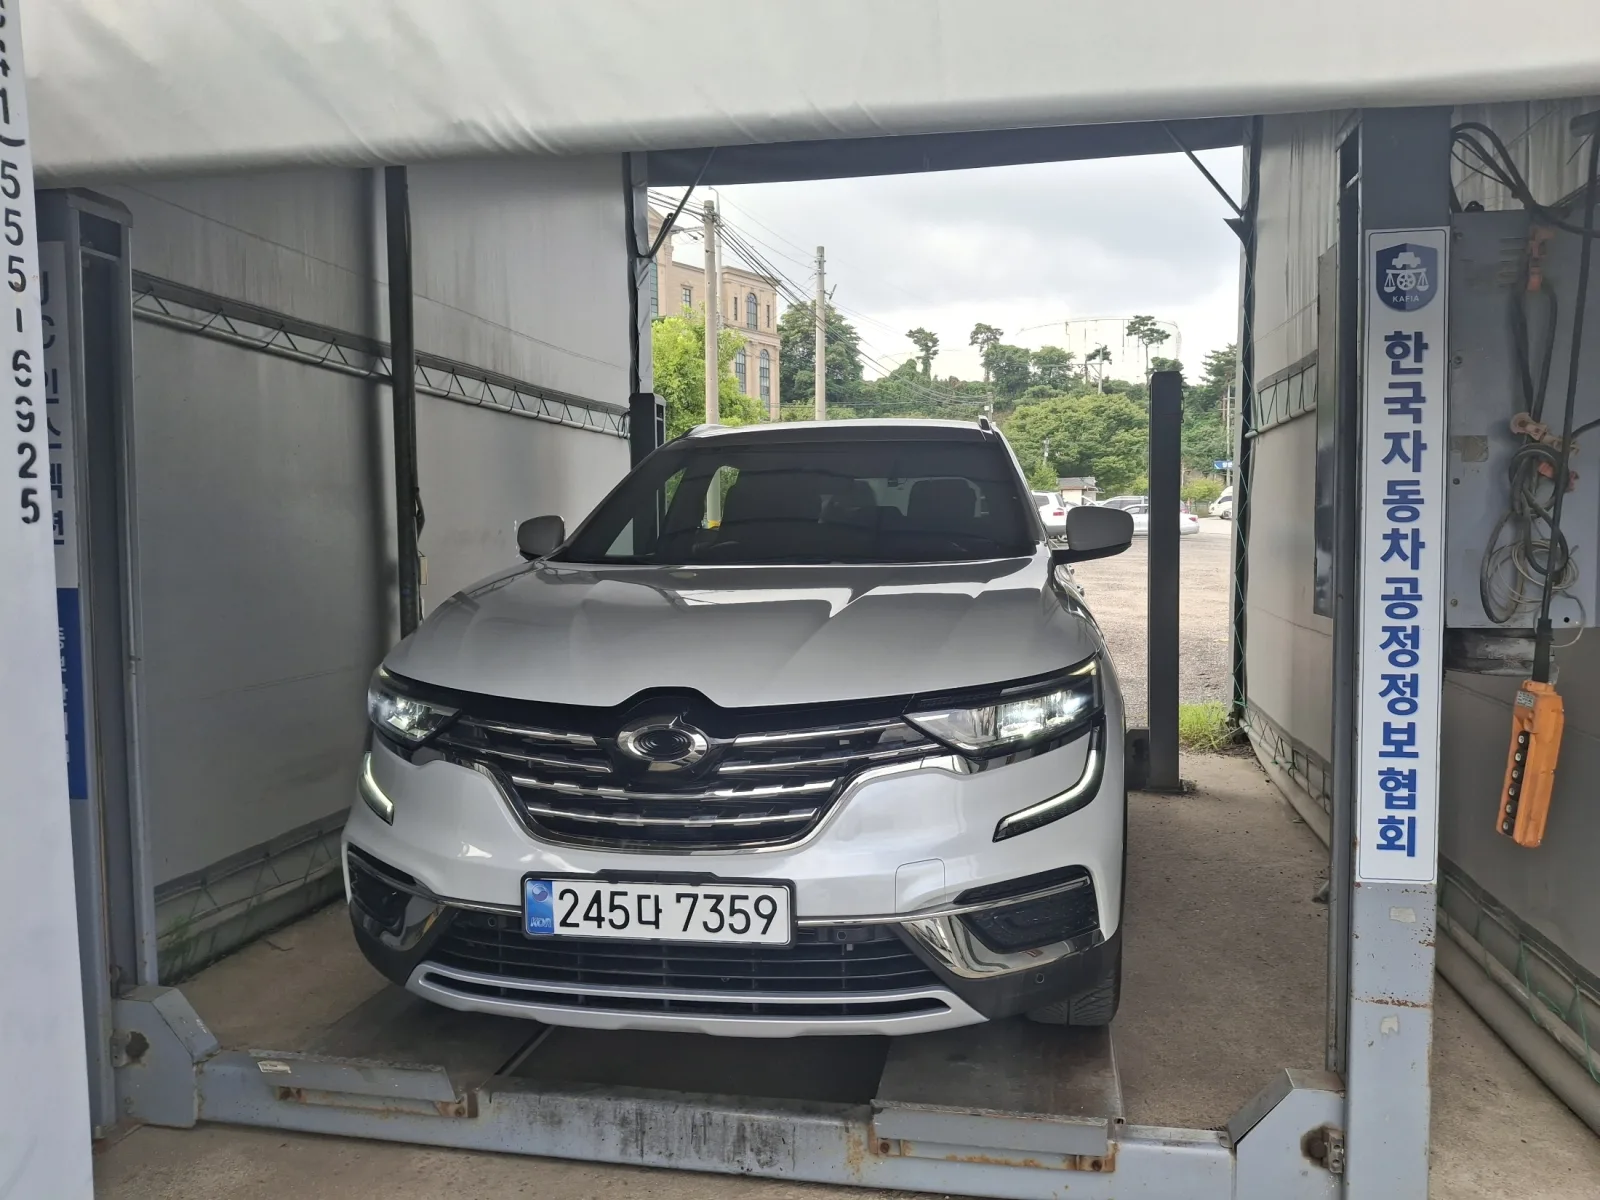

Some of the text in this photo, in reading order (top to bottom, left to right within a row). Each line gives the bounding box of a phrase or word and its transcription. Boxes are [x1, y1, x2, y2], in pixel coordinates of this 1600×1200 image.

[1392, 295, 1420, 303] KAFIA
[1376, 330, 1429, 858] 한국자동차공정정보협회
[530, 917, 552, 928] KOR
[558, 888, 778, 935] 245다 7359
